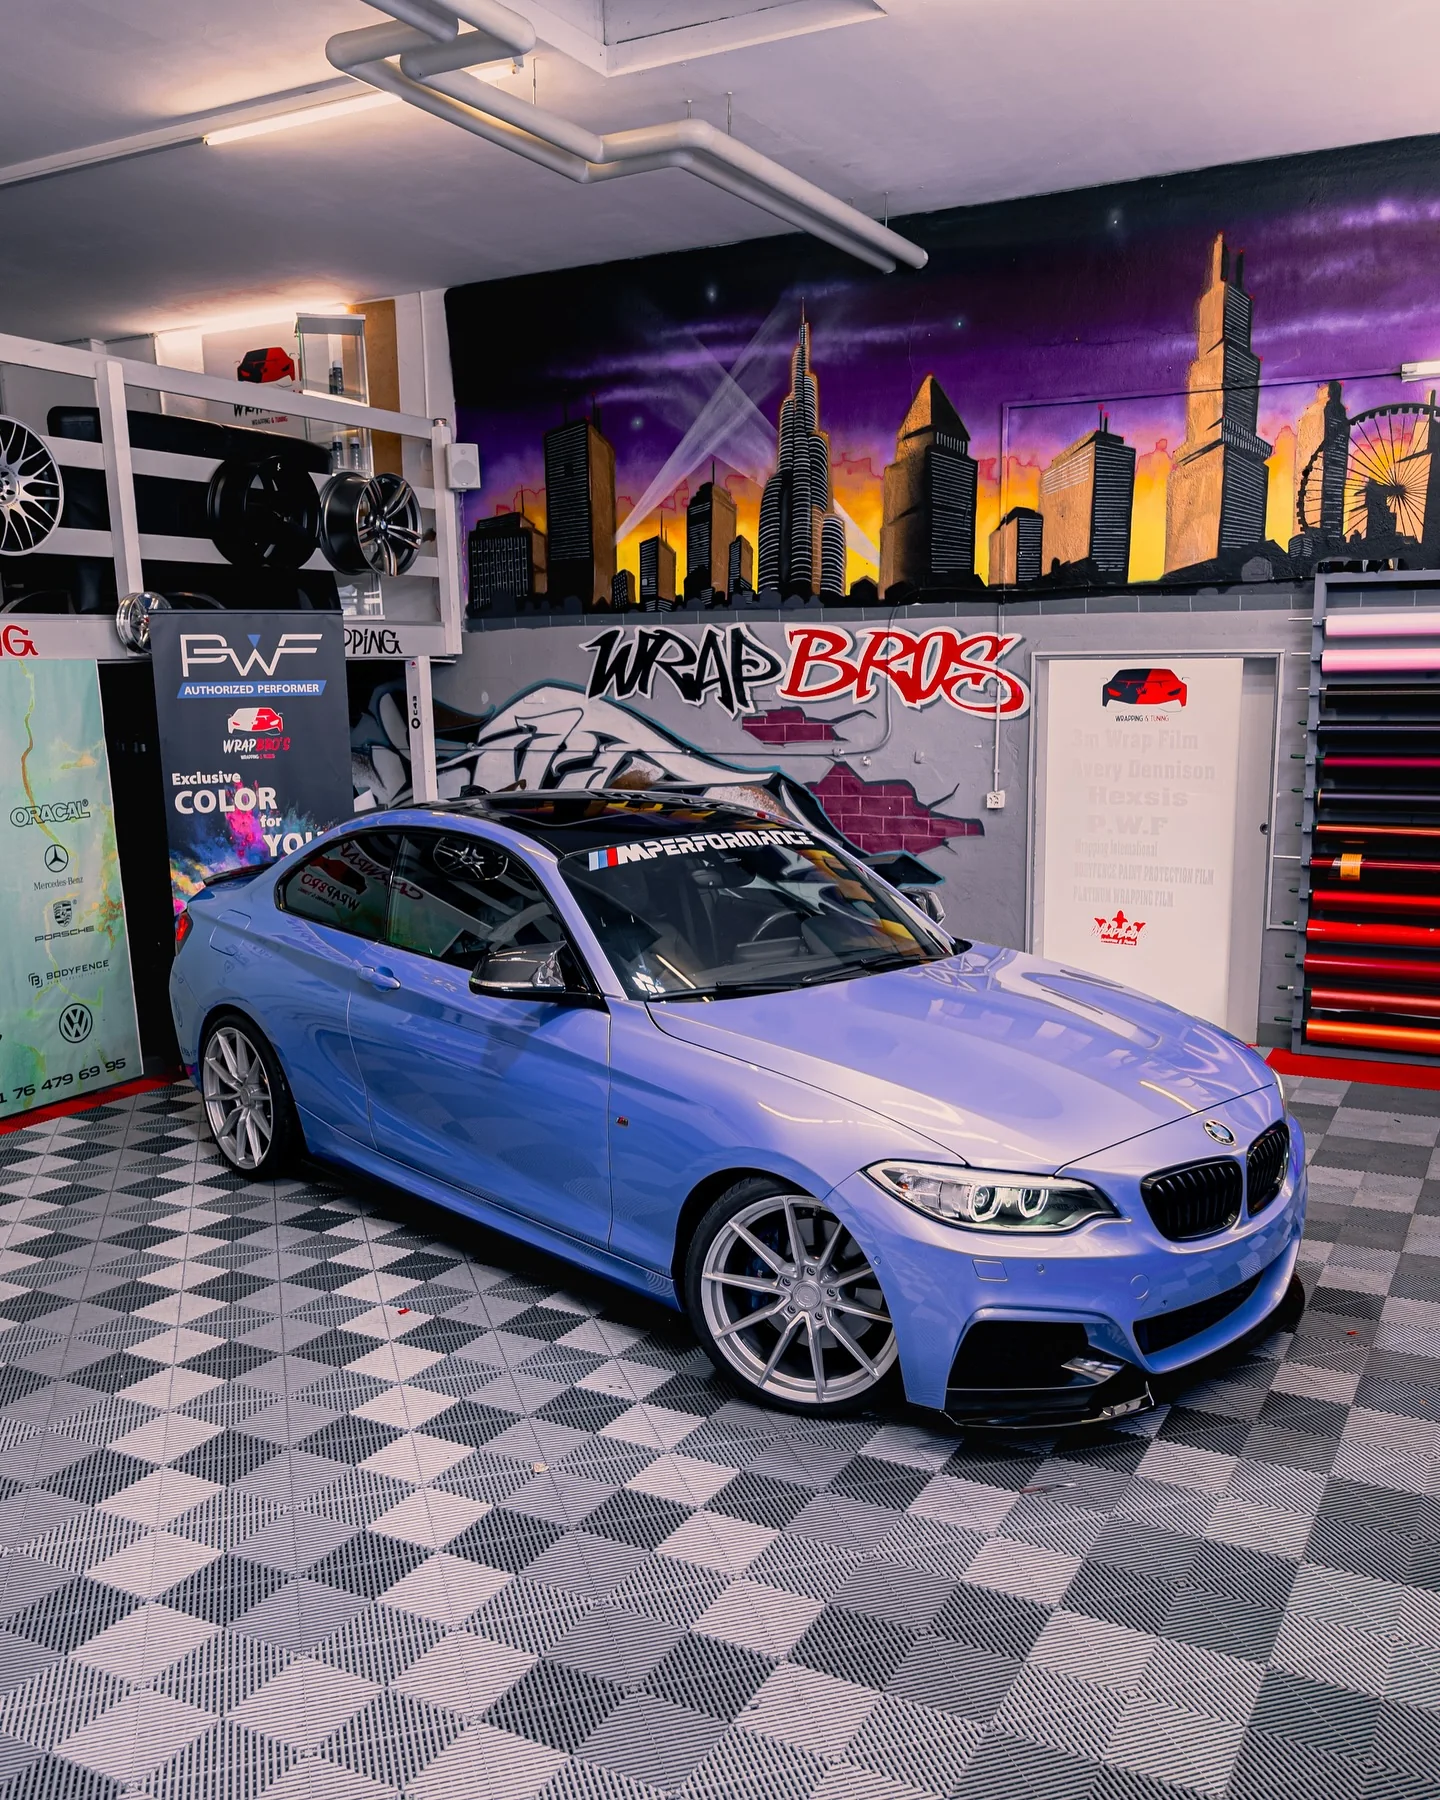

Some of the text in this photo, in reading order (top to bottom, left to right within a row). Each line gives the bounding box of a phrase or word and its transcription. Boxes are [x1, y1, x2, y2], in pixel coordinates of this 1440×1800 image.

[180, 634, 323, 677] PWF
[580, 623, 1030, 719] WRAP BROS
[184, 683, 319, 695] AUTHORIZED PERFORMER
[1105, 728, 1152, 754] Wrap
[1158, 729, 1198, 750] Film
[172, 770, 241, 786] Exclusive
[1072, 758, 1216, 783] Avery Dennison
[174, 787, 278, 815] COLOR
[1087, 786, 1188, 807] Hexsis
[259, 815, 282, 828] for
[1087, 815, 1168, 836] P.W.F
[1144, 865, 1194, 884] PROTECTION
[1194, 868, 1215, 886] FILM
[1113, 887, 1155, 906] WRAPPING
[1154, 890, 1175, 908] FILM
[34, 925, 94, 942] PORSCHE
[46, 960, 109, 980] BODYFENCE
[13, 1084, 36, 1100] 76
[41, 1073, 74, 1089] 479
[79, 1065, 100, 1080] 69
[105, 1058, 126, 1073] 95
